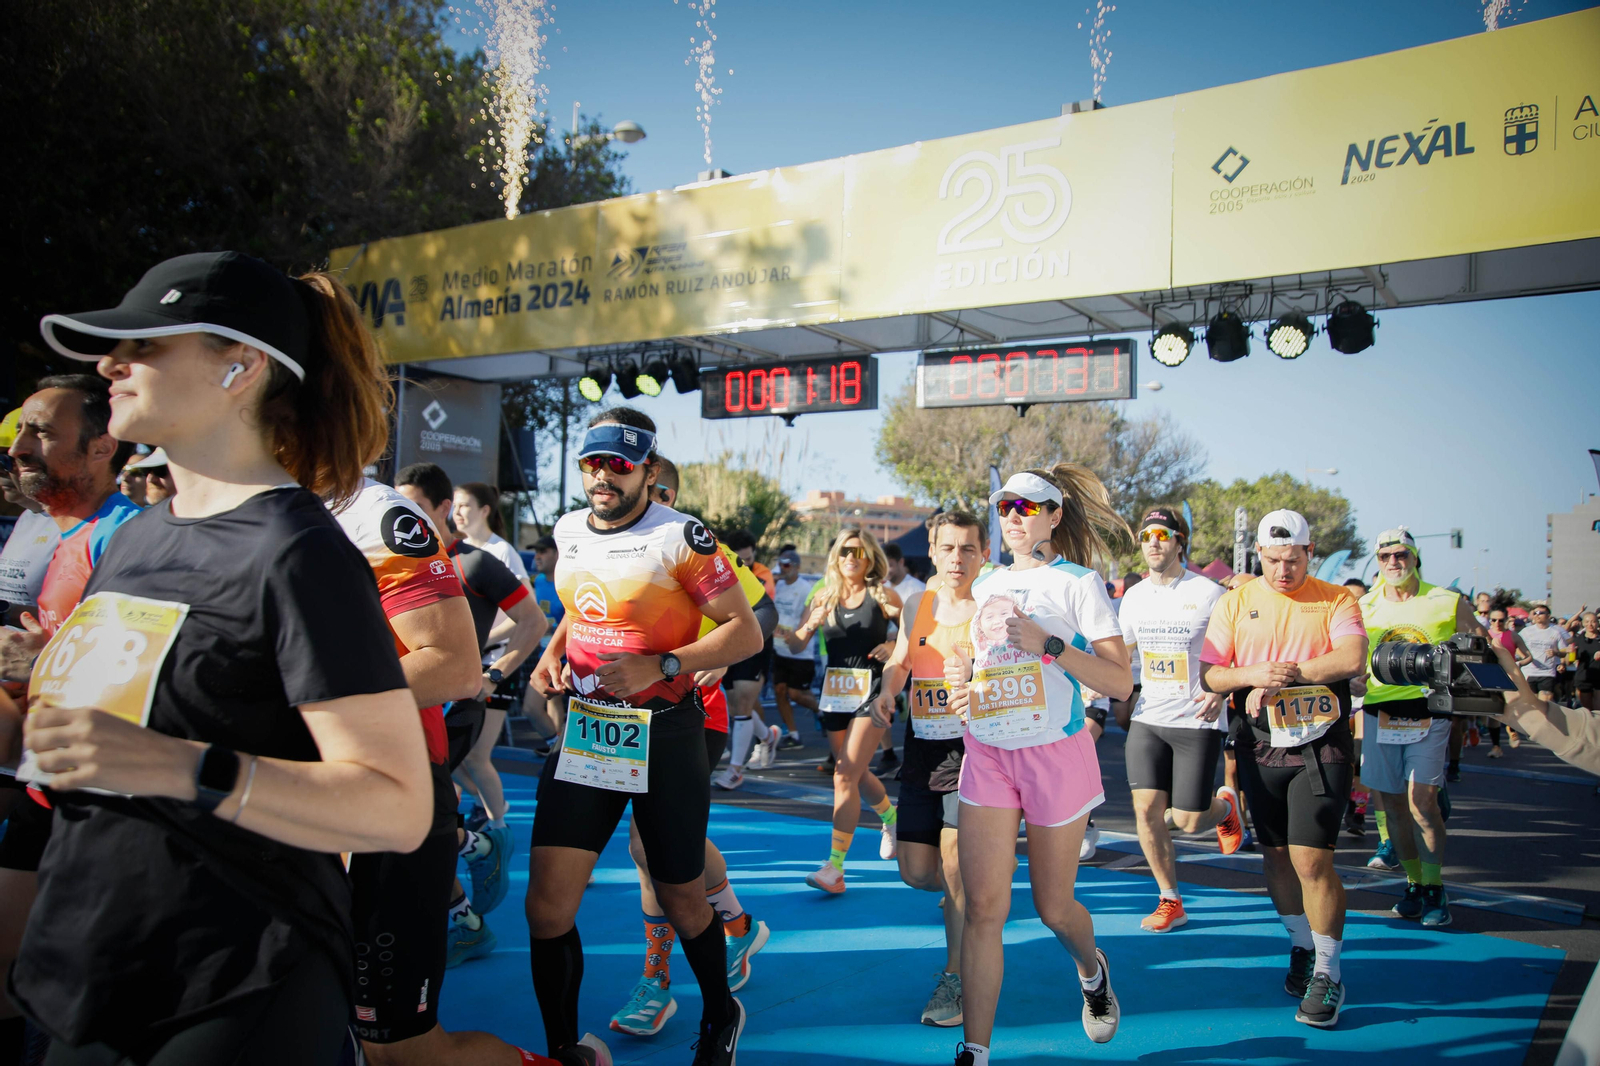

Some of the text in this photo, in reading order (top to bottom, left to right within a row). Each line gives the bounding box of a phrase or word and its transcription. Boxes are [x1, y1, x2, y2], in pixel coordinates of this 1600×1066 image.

[1350, 173, 1376, 184] 2020
[937, 136, 1073, 255] 25
[1209, 176, 1315, 202] COOPERACIÓN
[1209, 200, 1244, 214] 2005
[442, 252, 593, 293] Medio Maratón
[933, 247, 1070, 291] EDICIÓN
[603, 264, 791, 303] RAMÓN RUIZ ANDÚJAR
[440, 279, 591, 321] Almería 2024
[1138, 626, 1192, 635] Almería 2024
[1159, 619, 1191, 627] Maratón
[603, 637, 624, 647] CAR
[37, 623, 149, 686] 1628
[1149, 659, 1176, 674] 441
[829, 674, 864, 691] 1101
[974, 674, 1037, 704] 1396
[914, 688, 949, 707] 119
[978, 703, 990, 711] POR
[998, 697, 1034, 707] PRINCESA
[1275, 695, 1333, 717] 1178
[577, 715, 641, 749] 1102
[591, 743, 617, 754] FAUSTO
